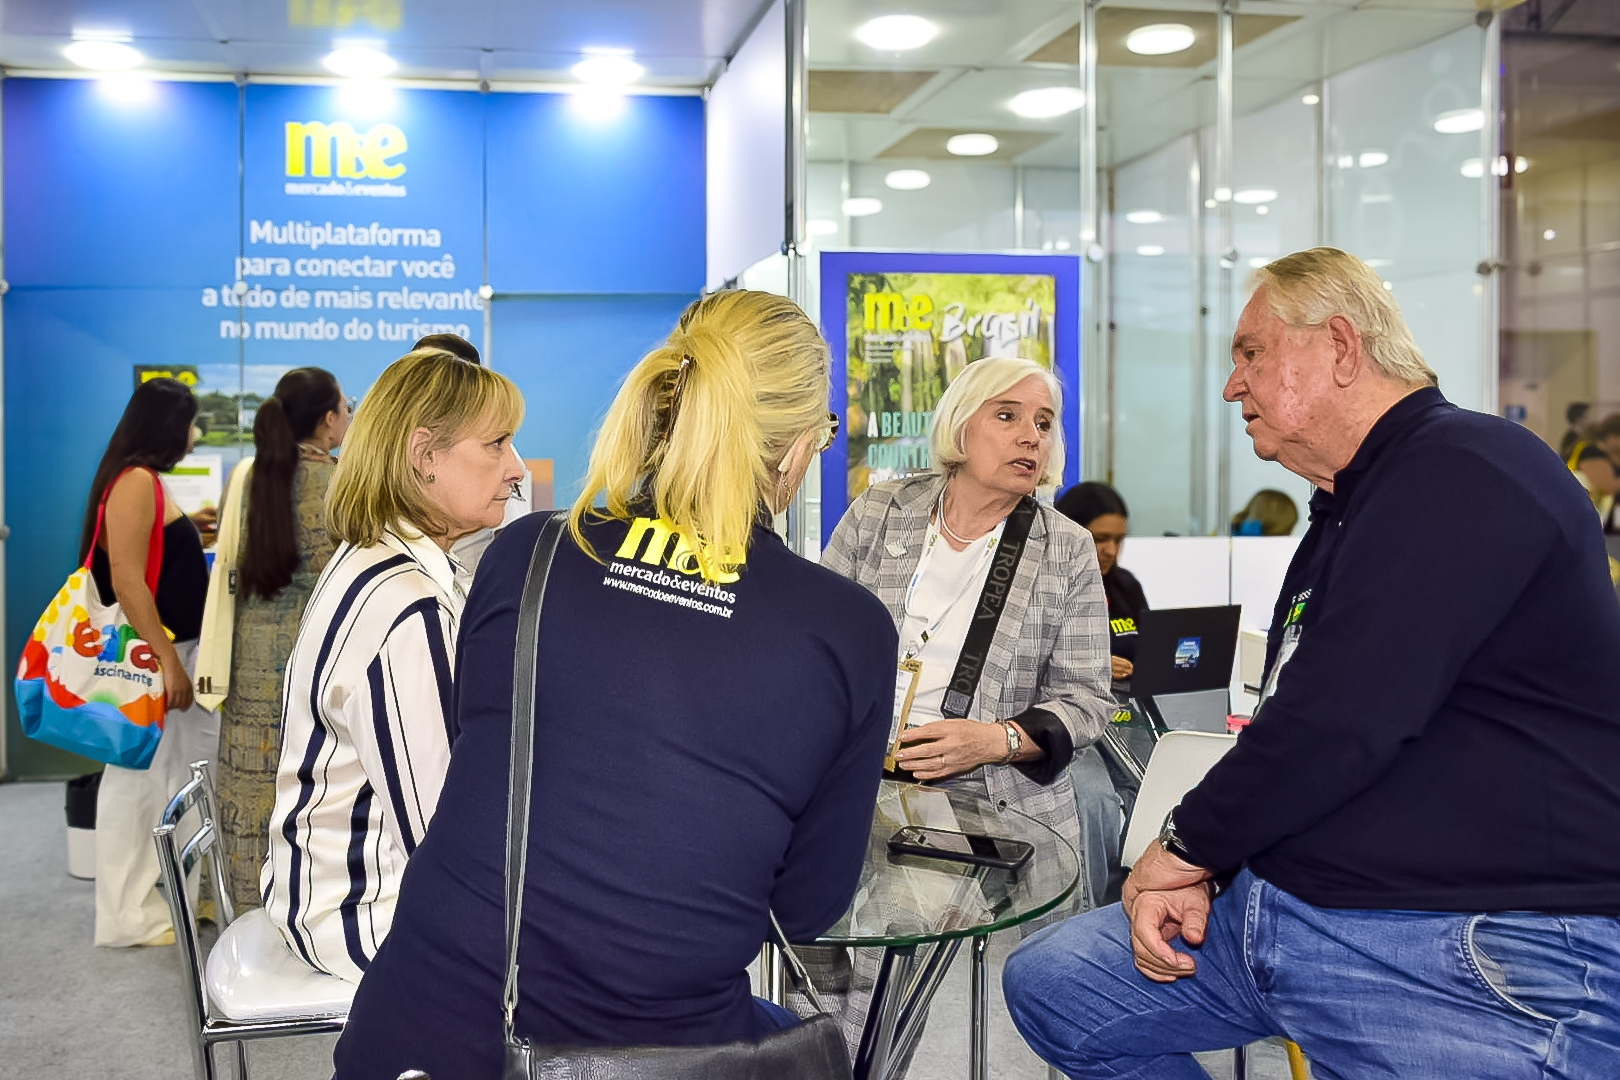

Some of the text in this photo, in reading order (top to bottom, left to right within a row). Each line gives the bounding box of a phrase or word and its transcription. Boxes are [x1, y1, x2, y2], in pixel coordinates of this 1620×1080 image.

[249, 219, 441, 250] Multiplataforma
[235, 253, 456, 281] para conectar você
[202, 288, 218, 307] a
[280, 284, 310, 308] de
[314, 285, 373, 309] mais
[377, 286, 484, 310] relevante
[220, 320, 251, 339] no
[255, 317, 340, 340] mundo
[343, 317, 374, 341] do
[939, 298, 1041, 347] Brasil
[867, 411, 878, 438] A
[609, 561, 737, 604] mercado&eventos
[977, 541, 1021, 620] TROPEA
[603, 576, 734, 618] www.mercadoeeventos.com.br
